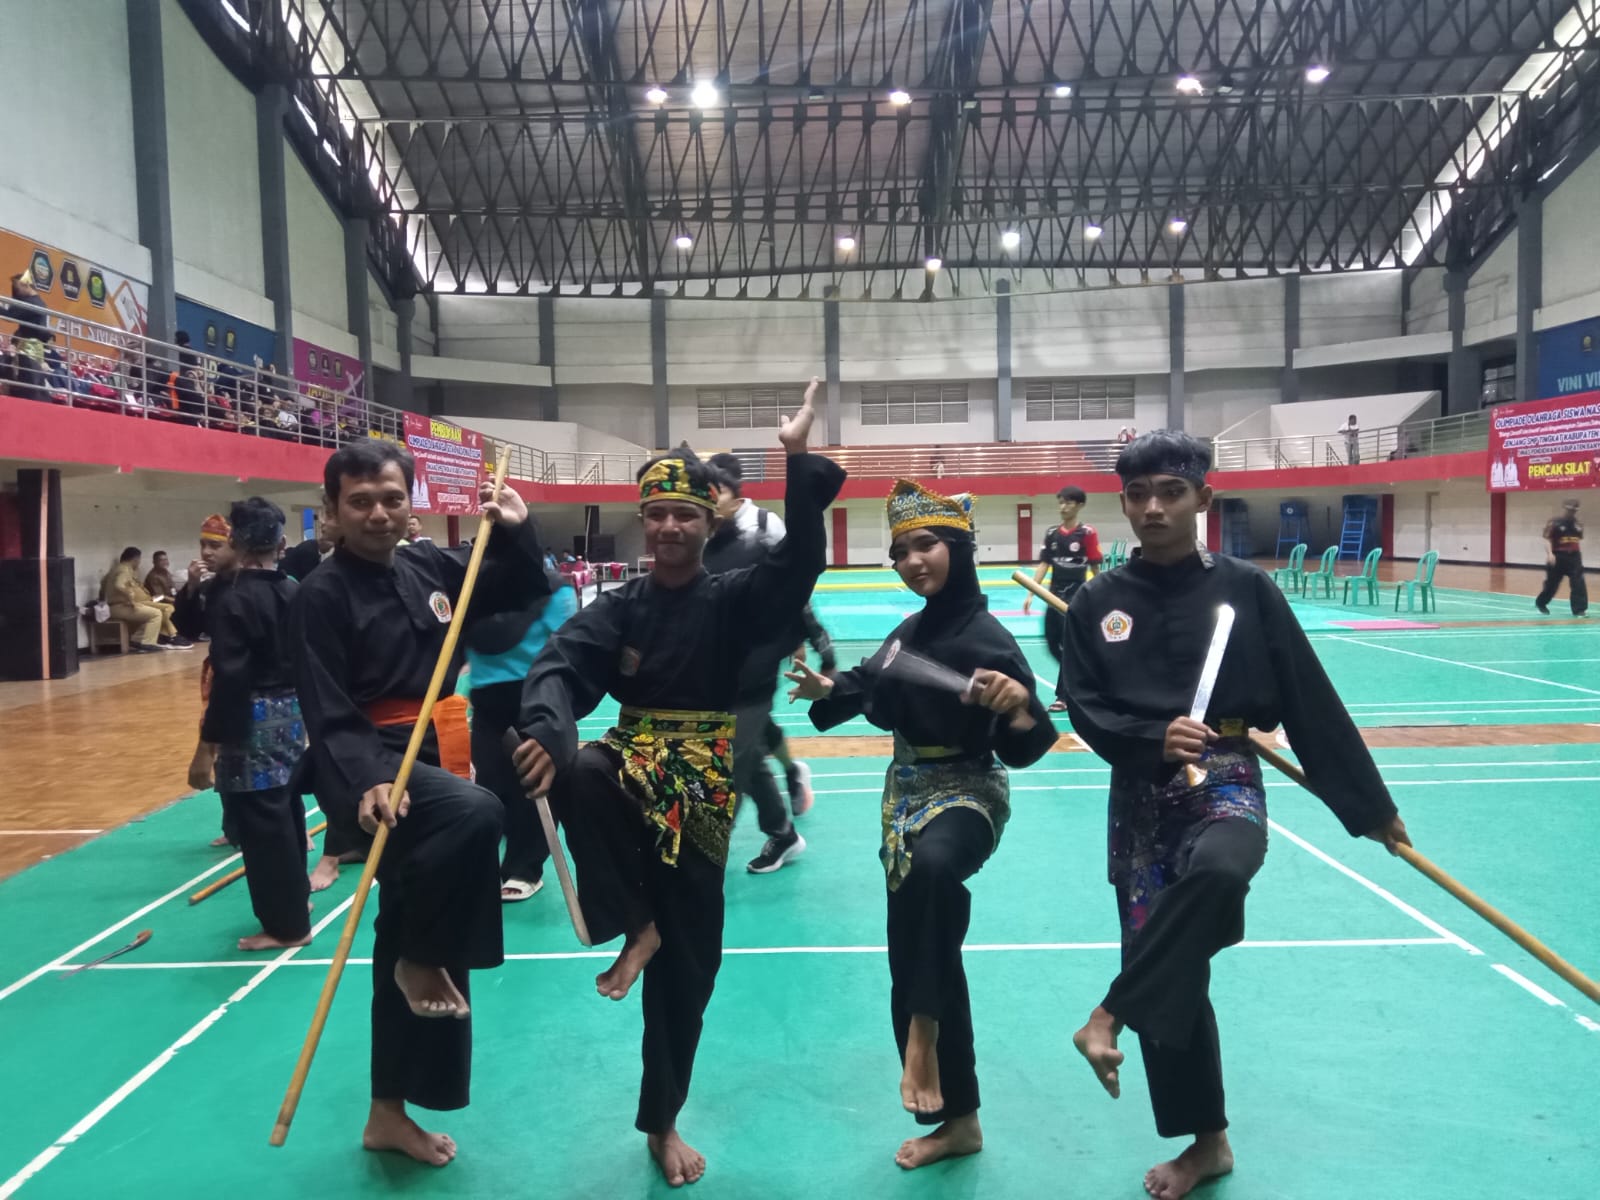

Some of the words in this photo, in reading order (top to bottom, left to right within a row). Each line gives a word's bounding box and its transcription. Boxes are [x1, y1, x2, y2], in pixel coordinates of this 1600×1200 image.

[1557, 375, 1582, 392] VINI
[1495, 417, 1526, 429] OLIMPIADE
[1527, 411, 1562, 424] OLAHRAGA
[1563, 407, 1585, 418] SISWA
[1504, 438, 1527, 448] JENJANG
[1527, 437, 1538, 446] SMP
[1539, 433, 1563, 444] TINGKAT
[1563, 429, 1599, 441] KABUPATEN
[1528, 463, 1563, 477] PENCAK
[1564, 461, 1590, 475] SILAT
